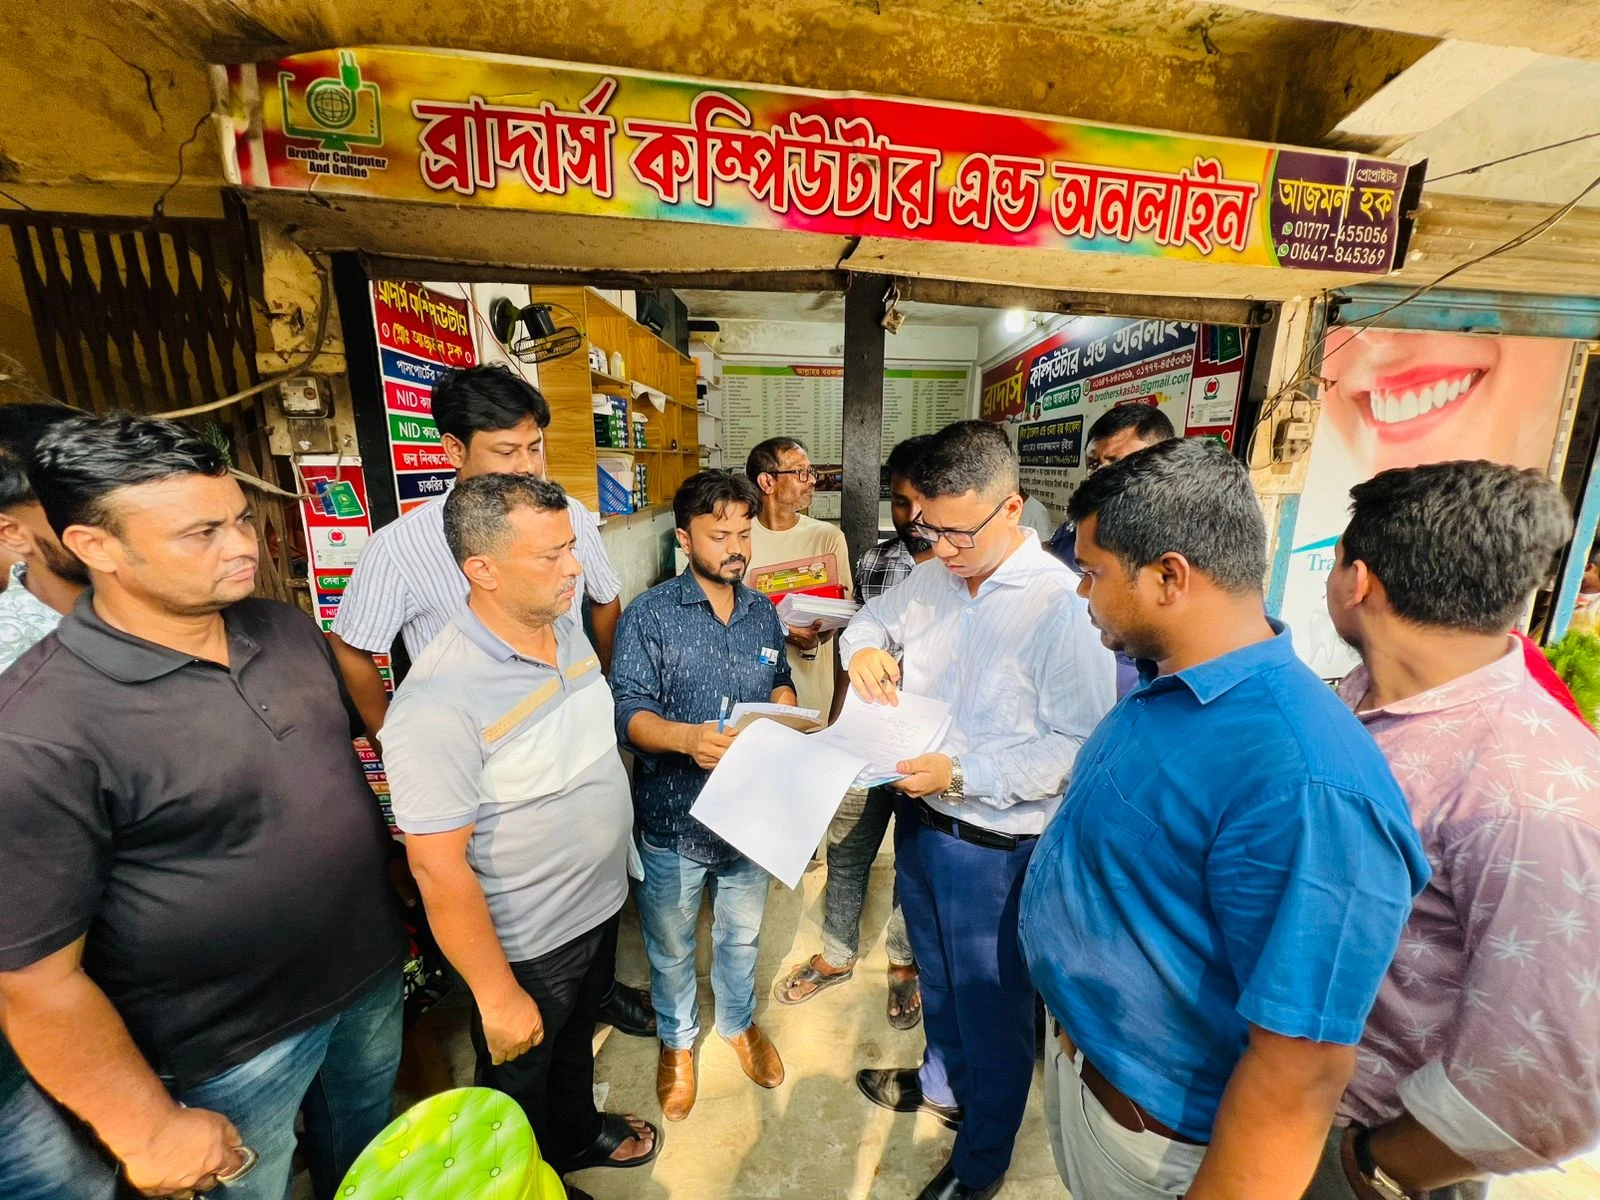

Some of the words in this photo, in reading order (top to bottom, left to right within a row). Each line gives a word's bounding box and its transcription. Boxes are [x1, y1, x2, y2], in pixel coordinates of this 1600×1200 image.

[287, 147, 330, 162] Brother
[332, 151, 387, 169] Computer
[411, 76, 617, 196] ব্রাদার্স
[624, 90, 940, 229] কম্পিউটার
[949, 153, 1045, 233] এন্ড
[1052, 156, 1259, 254] অনলাইন
[309, 162, 330, 174] And
[332, 163, 369, 178] Online
[1278, 178, 1354, 219] আজমল
[1359, 186, 1395, 222] হক
[1294, 220, 1389, 244] 01777-455056
[1290, 242, 1386, 265] 01647-845369
[983, 359, 1024, 416] ব্রাদার্স
[1029, 347, 1081, 388] কম্পিউটার
[396, 389, 418, 407] NID
[398, 421, 421, 438] NID
